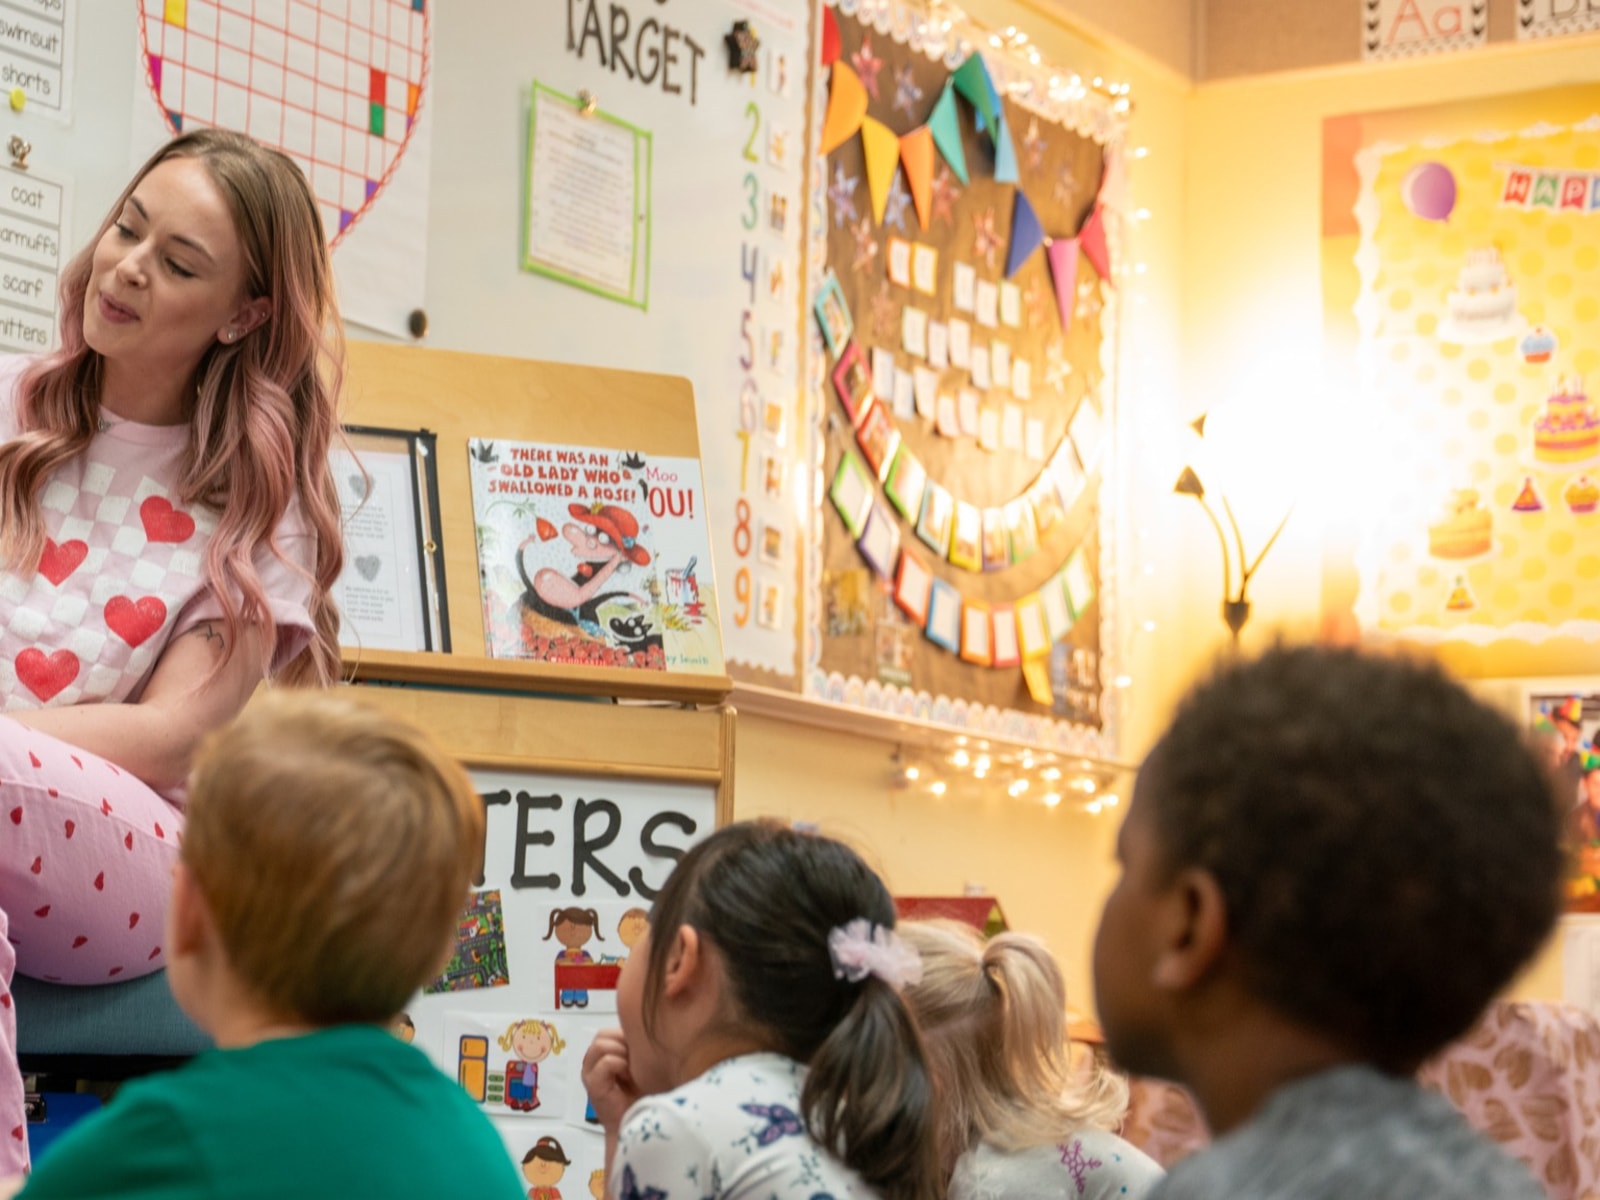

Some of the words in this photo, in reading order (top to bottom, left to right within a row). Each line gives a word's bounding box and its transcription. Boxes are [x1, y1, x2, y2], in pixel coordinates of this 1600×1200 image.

[566, 0, 705, 106] TARGET
[2, 64, 50, 95] shorts
[742, 101, 760, 163] 2
[11, 185, 45, 209] coat
[741, 172, 759, 230] 3
[0, 226, 57, 256] armuffs
[2, 273, 43, 298] scarf
[741, 242, 758, 304] 4
[739, 309, 754, 371] 5
[500, 463, 534, 478] OLD
[538, 465, 578, 481] LADY
[584, 468, 621, 484] WHO
[510, 448, 552, 462] THERE
[556, 450, 585, 464] WAS
[588, 452, 609, 467] AN
[646, 466, 678, 482] Moo
[488, 479, 573, 497] SWALLOWED
[578, 485, 589, 499] A
[593, 485, 636, 504] ROSE!
[648, 486, 694, 519] OU!
[733, 497, 751, 558] 8
[733, 566, 751, 628] 9
[473, 789, 697, 901] TERS
